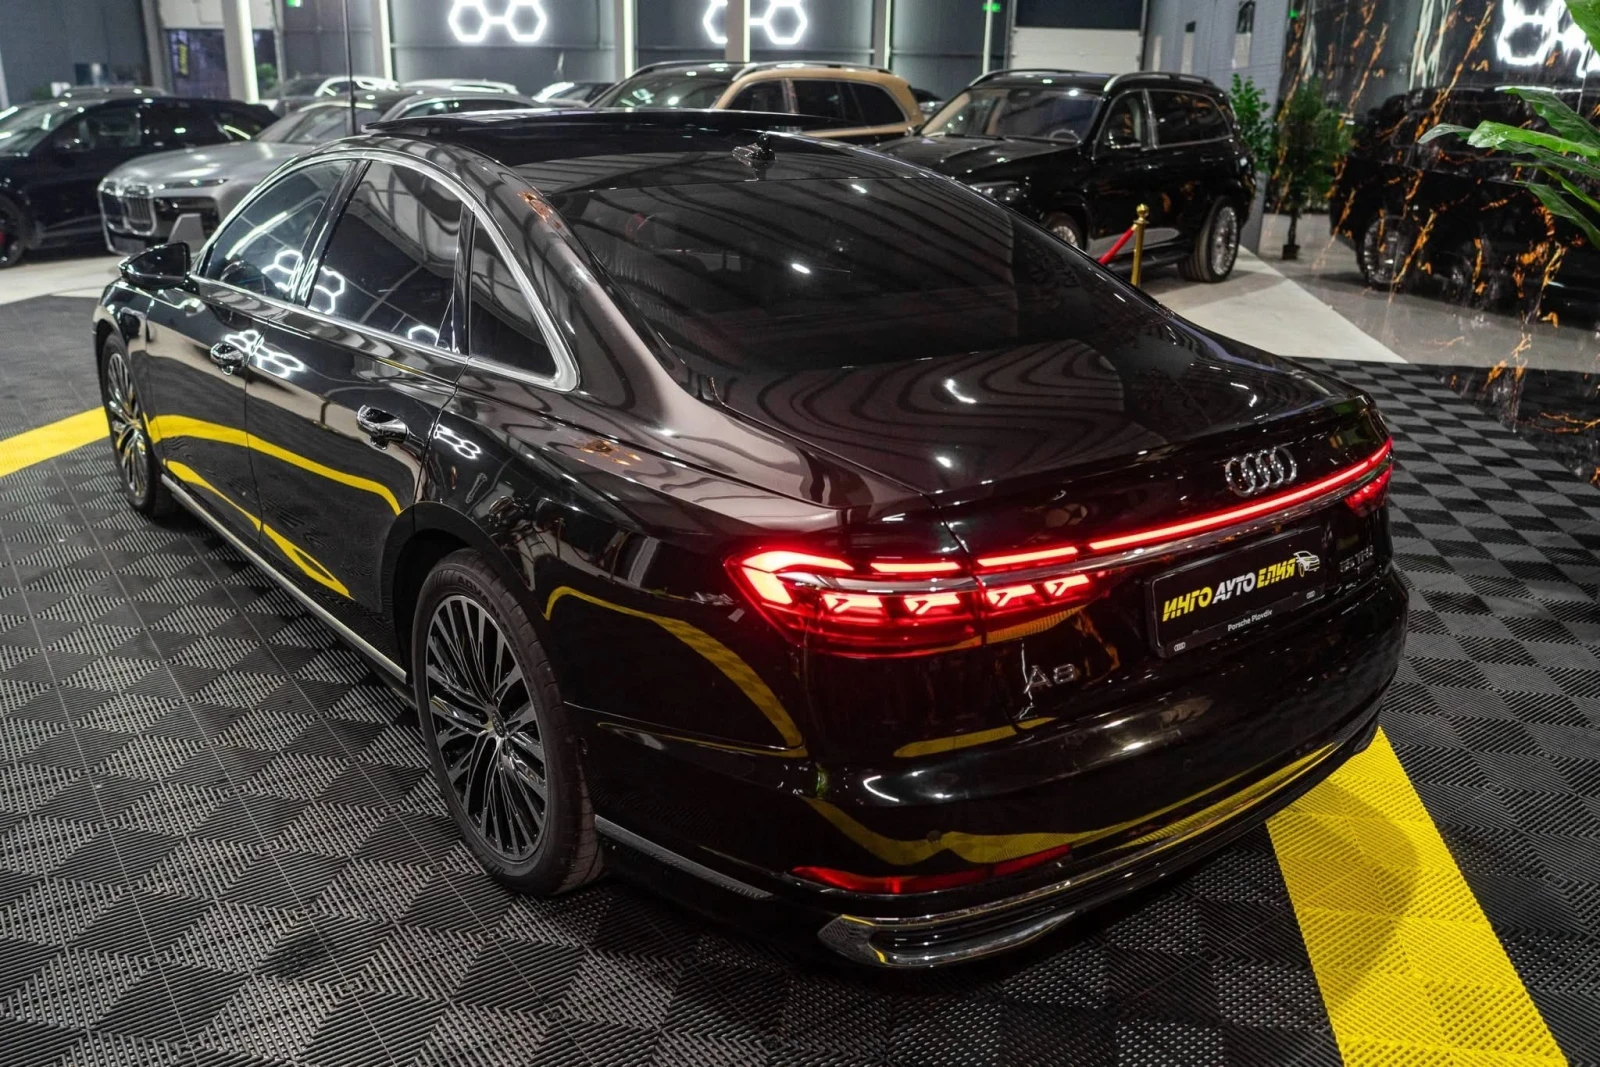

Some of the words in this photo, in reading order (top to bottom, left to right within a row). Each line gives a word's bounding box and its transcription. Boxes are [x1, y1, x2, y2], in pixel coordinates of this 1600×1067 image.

[1212, 572, 1256, 604] АУТО
[1257, 558, 1297, 588] ЕЛИЯ
[1228, 617, 1251, 631] Porsche
[1251, 609, 1273, 623] Plovdiv
[1024, 664, 1075, 694] A8
